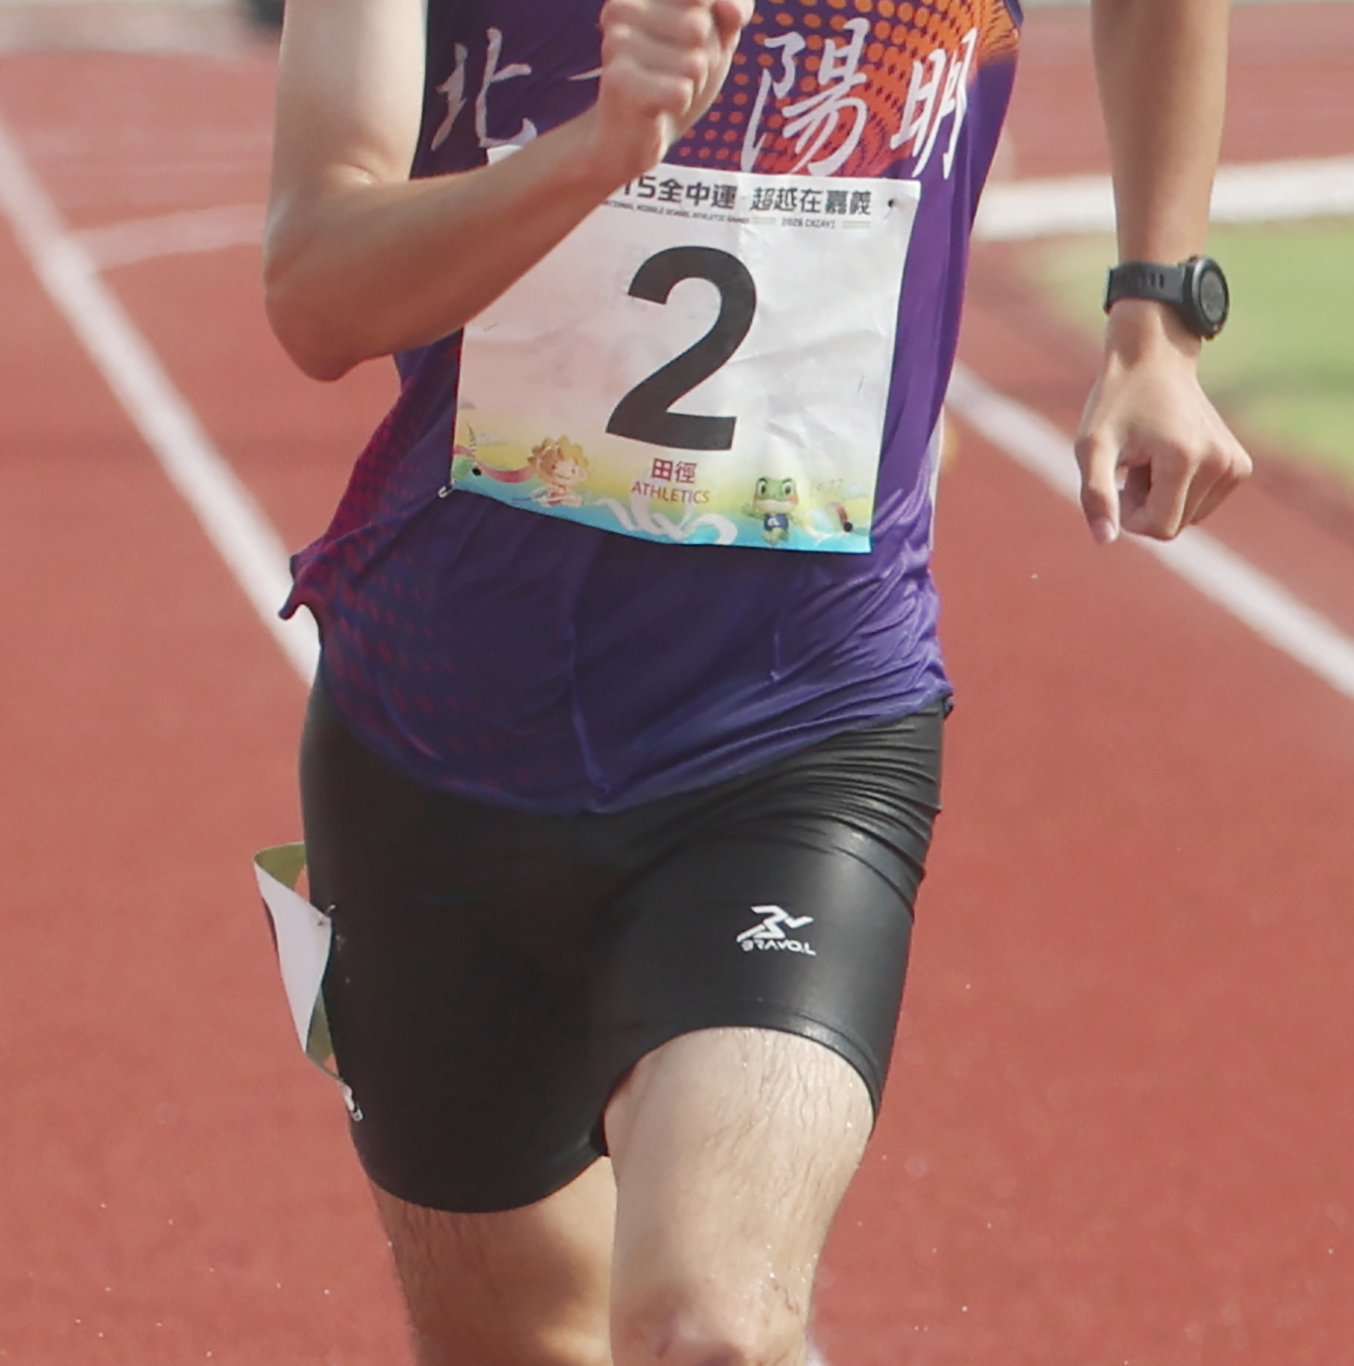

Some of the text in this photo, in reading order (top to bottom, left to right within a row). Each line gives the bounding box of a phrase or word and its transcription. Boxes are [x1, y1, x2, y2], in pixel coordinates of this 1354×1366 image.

[431, 17, 977, 180] 北陽明
[606, 245, 757, 451] 2
[631, 481, 710, 505] ATHLETICS
[651, 458, 698, 484] 田徑
